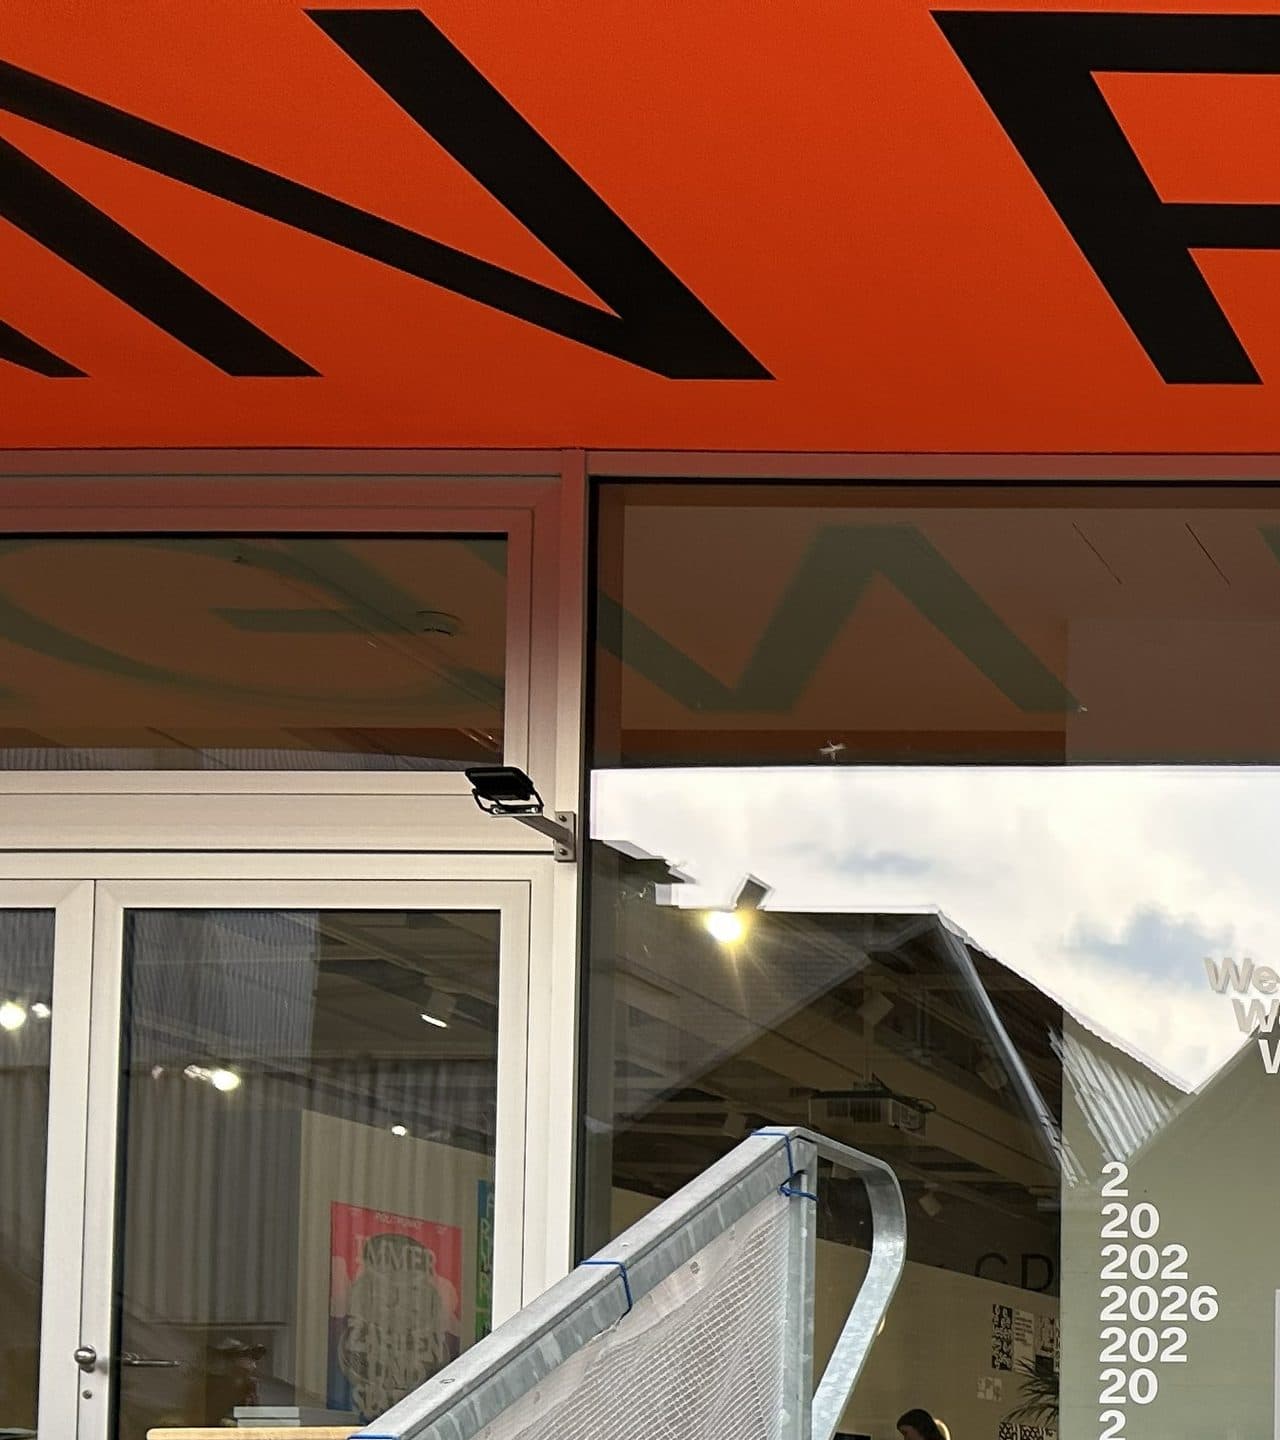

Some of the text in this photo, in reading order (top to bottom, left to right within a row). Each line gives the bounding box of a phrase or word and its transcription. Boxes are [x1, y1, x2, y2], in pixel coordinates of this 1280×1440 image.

[1101, 1163, 1128, 1197] 2
[1101, 1204, 1159, 1238] 20
[1101, 1245, 1188, 1280] 202
[1101, 1287, 1218, 1321] 2026
[1100, 1328, 1187, 1362] 202
[1100, 1369, 1157, 1403] 20
